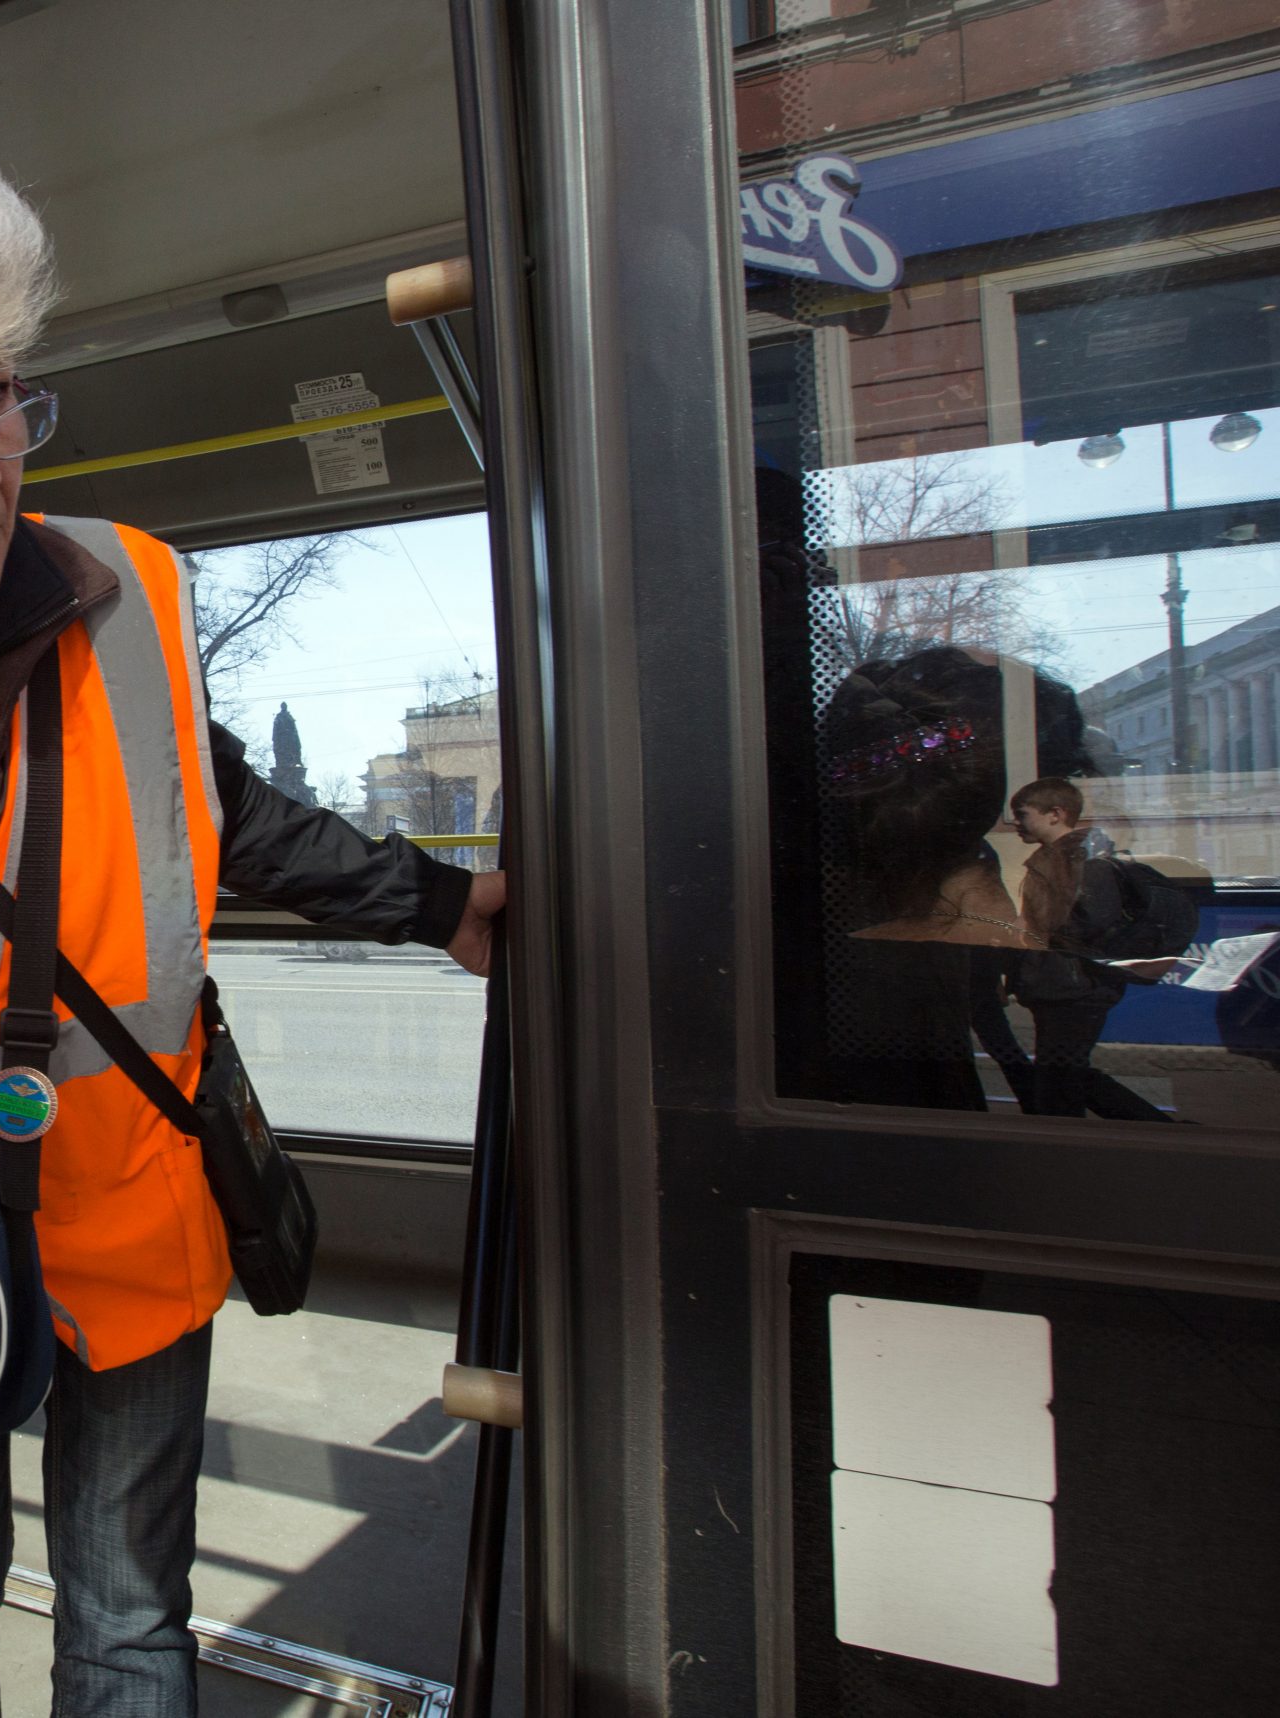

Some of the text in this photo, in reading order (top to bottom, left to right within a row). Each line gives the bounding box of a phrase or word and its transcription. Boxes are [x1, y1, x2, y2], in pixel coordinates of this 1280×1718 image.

[299, 379, 337, 390] СТОИМОСТЬ
[338, 375, 353, 389] 25
[299, 385, 339, 397] ПРОЕЗДА
[322, 400, 376, 416] 576-5555
[360, 437, 378, 448] 500
[366, 461, 383, 471] 100
